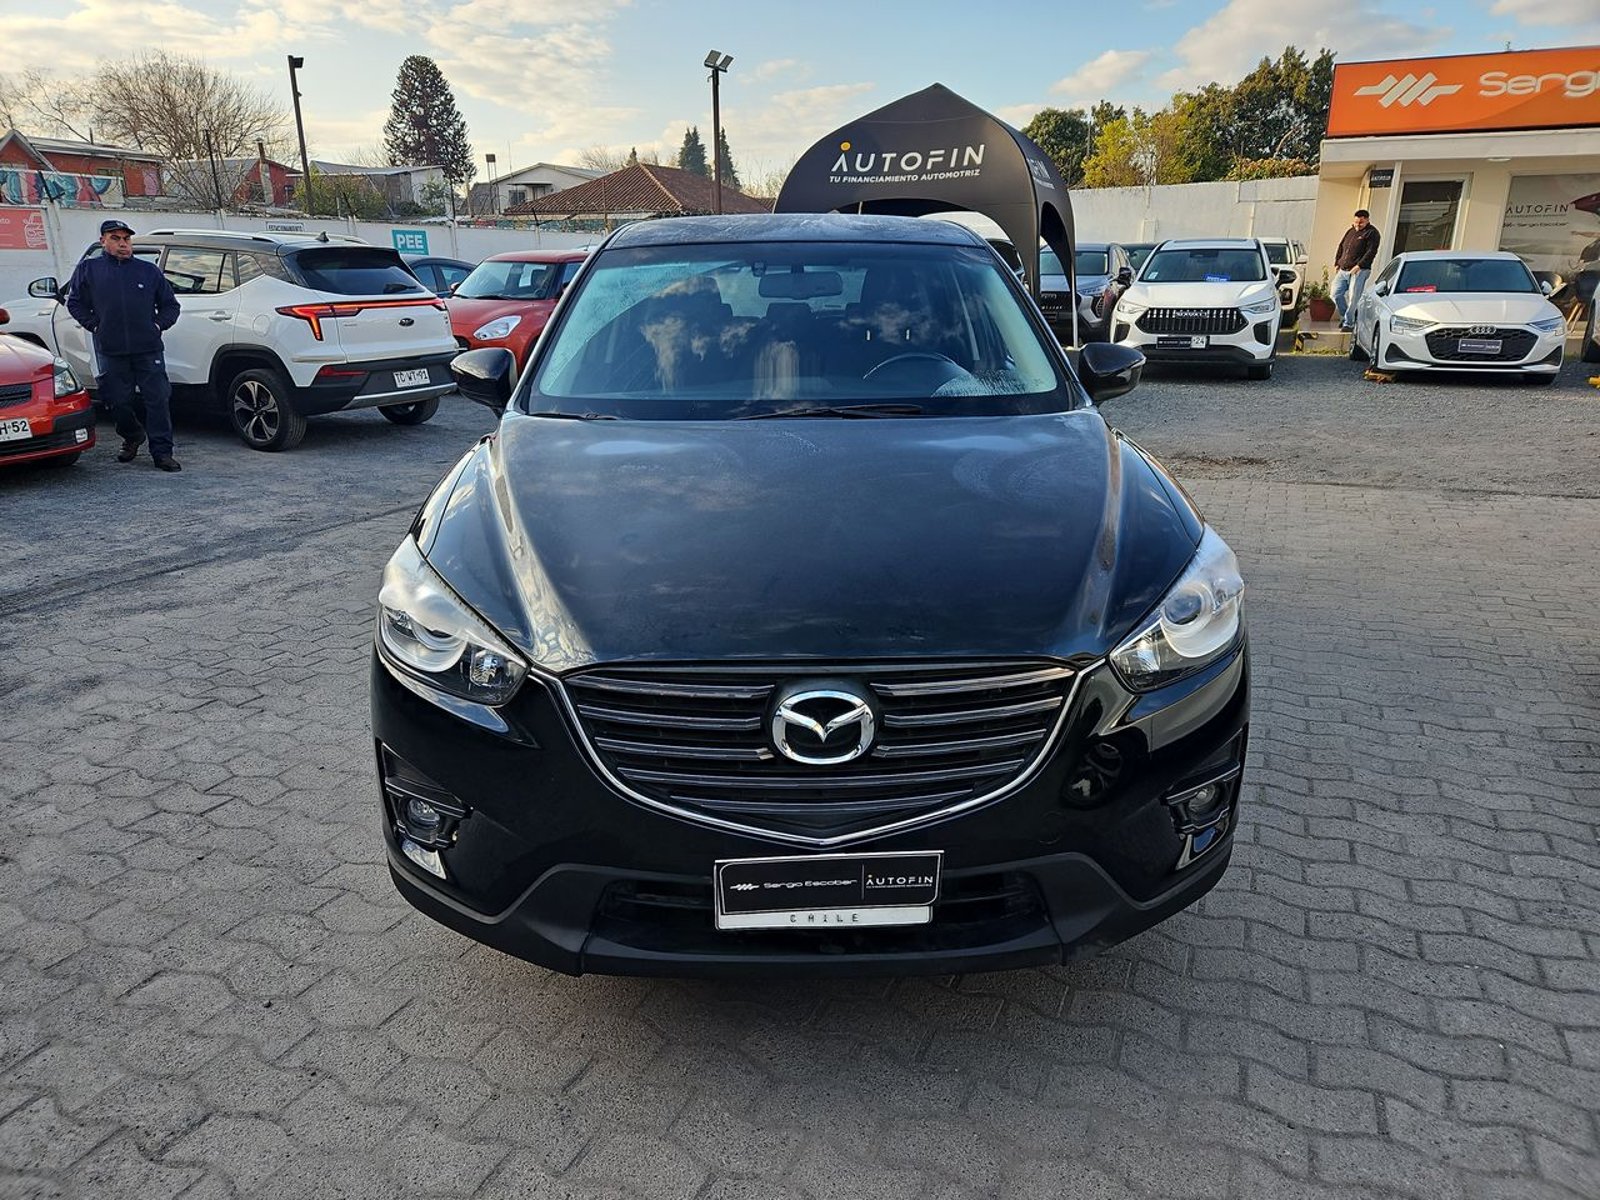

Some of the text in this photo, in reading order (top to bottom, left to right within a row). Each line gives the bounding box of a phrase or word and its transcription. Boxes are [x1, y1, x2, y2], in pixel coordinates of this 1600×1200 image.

[831, 142, 985, 172] AUTOFIN
[829, 169, 981, 183] TU FINANCIAMIENTO AUTOMOTRIZ
[1505, 203, 1569, 214] AUTOFIN
[396, 234, 424, 249] PEE
[866, 875, 934, 886] AUTOFIN
